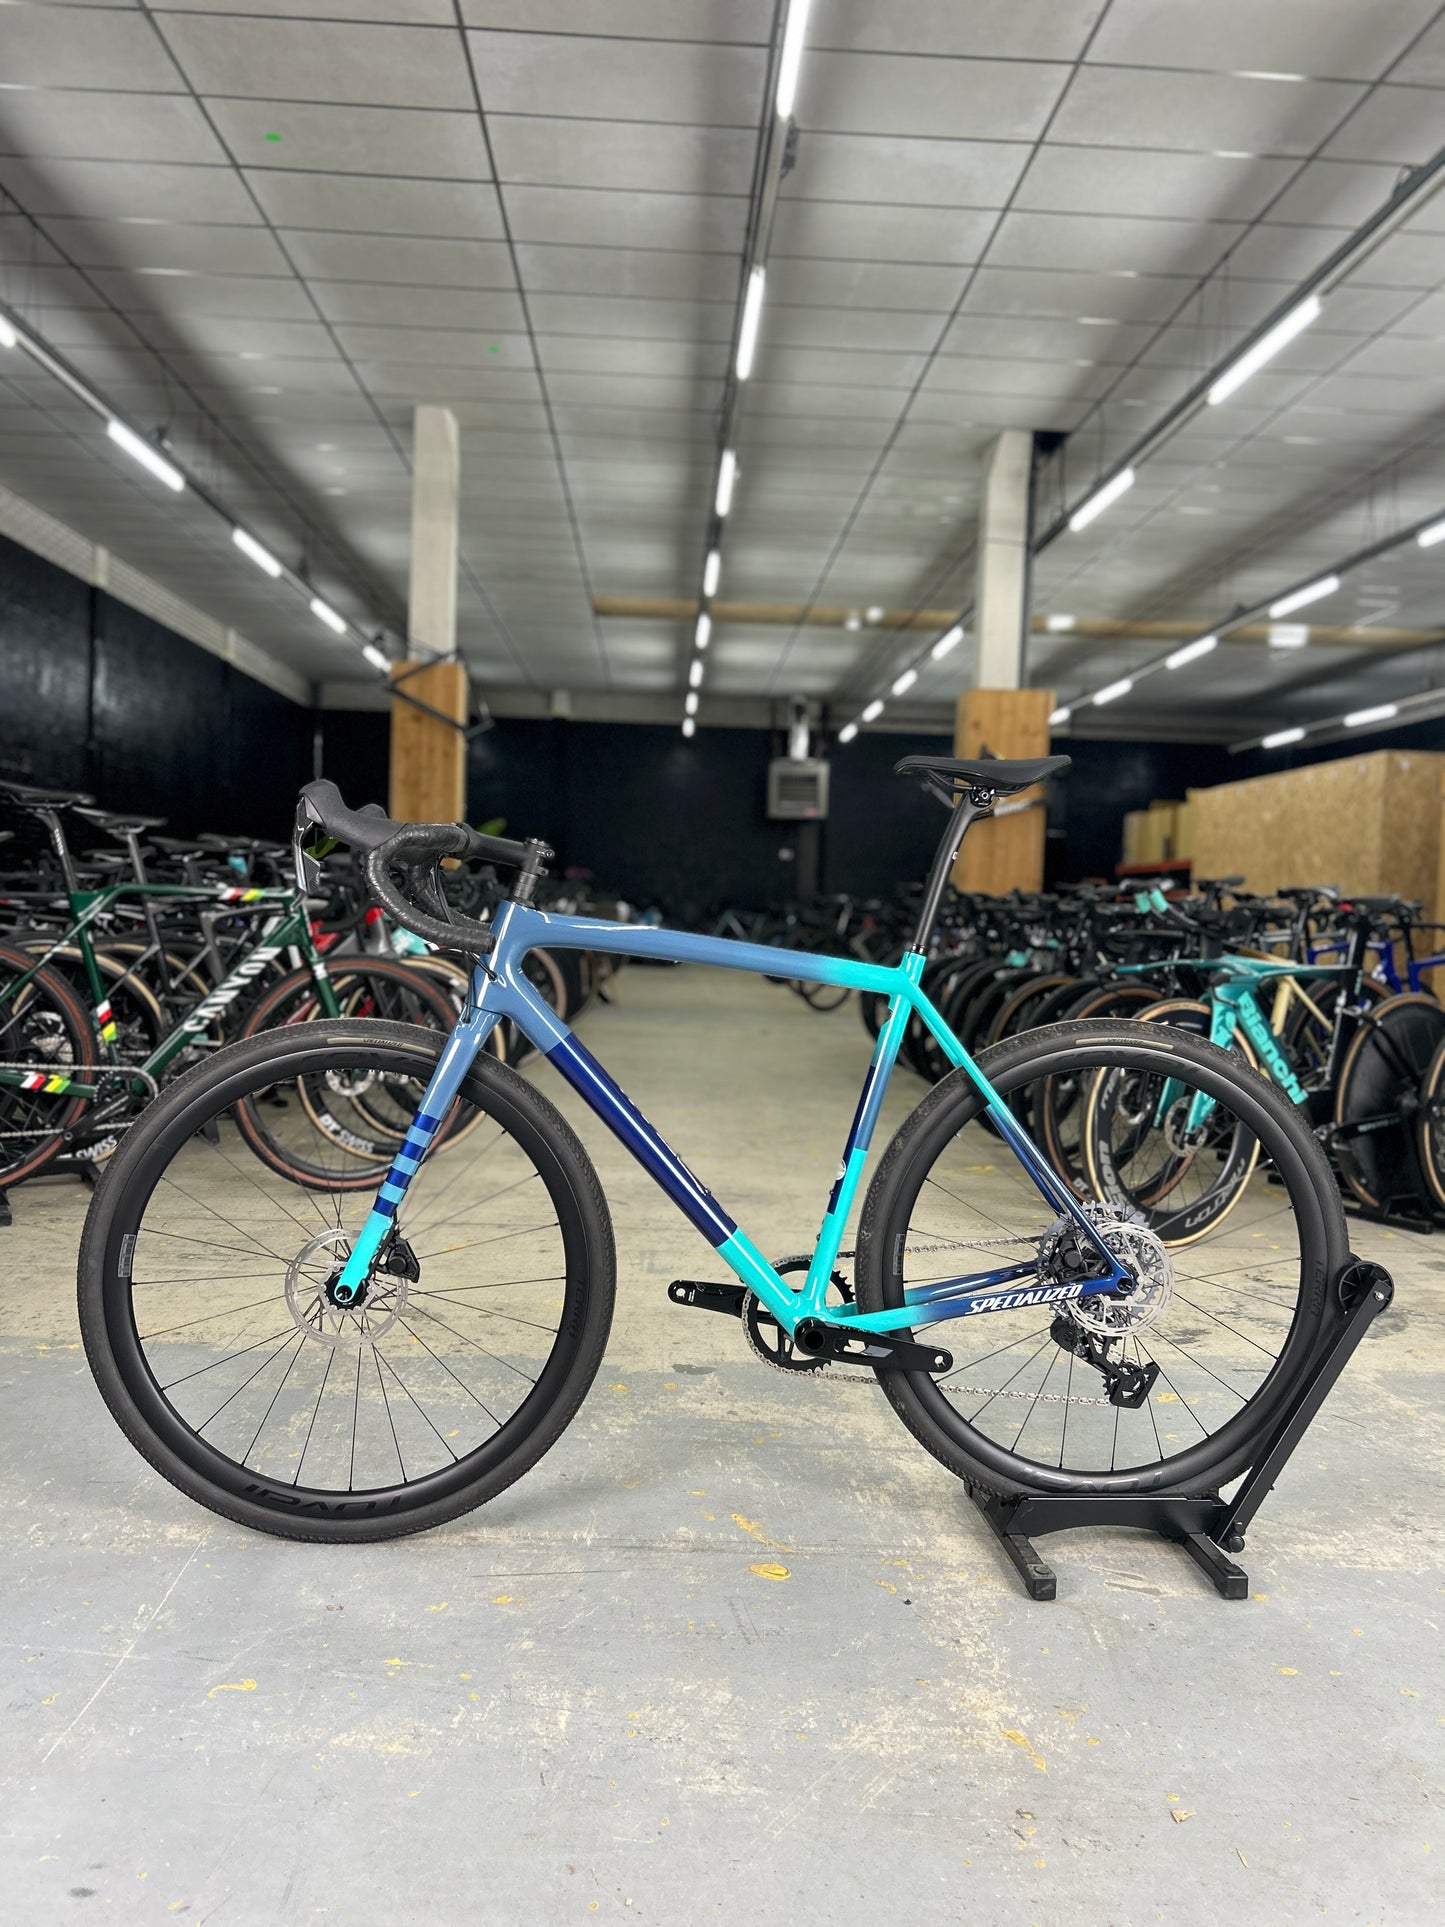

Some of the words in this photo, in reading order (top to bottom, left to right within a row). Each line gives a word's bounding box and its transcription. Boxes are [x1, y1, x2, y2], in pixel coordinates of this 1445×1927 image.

[182, 947, 283, 1032] CANYON
[1237, 990, 1309, 1105] Bianchi
[964, 1284, 1084, 1315] SPECIALIZED
